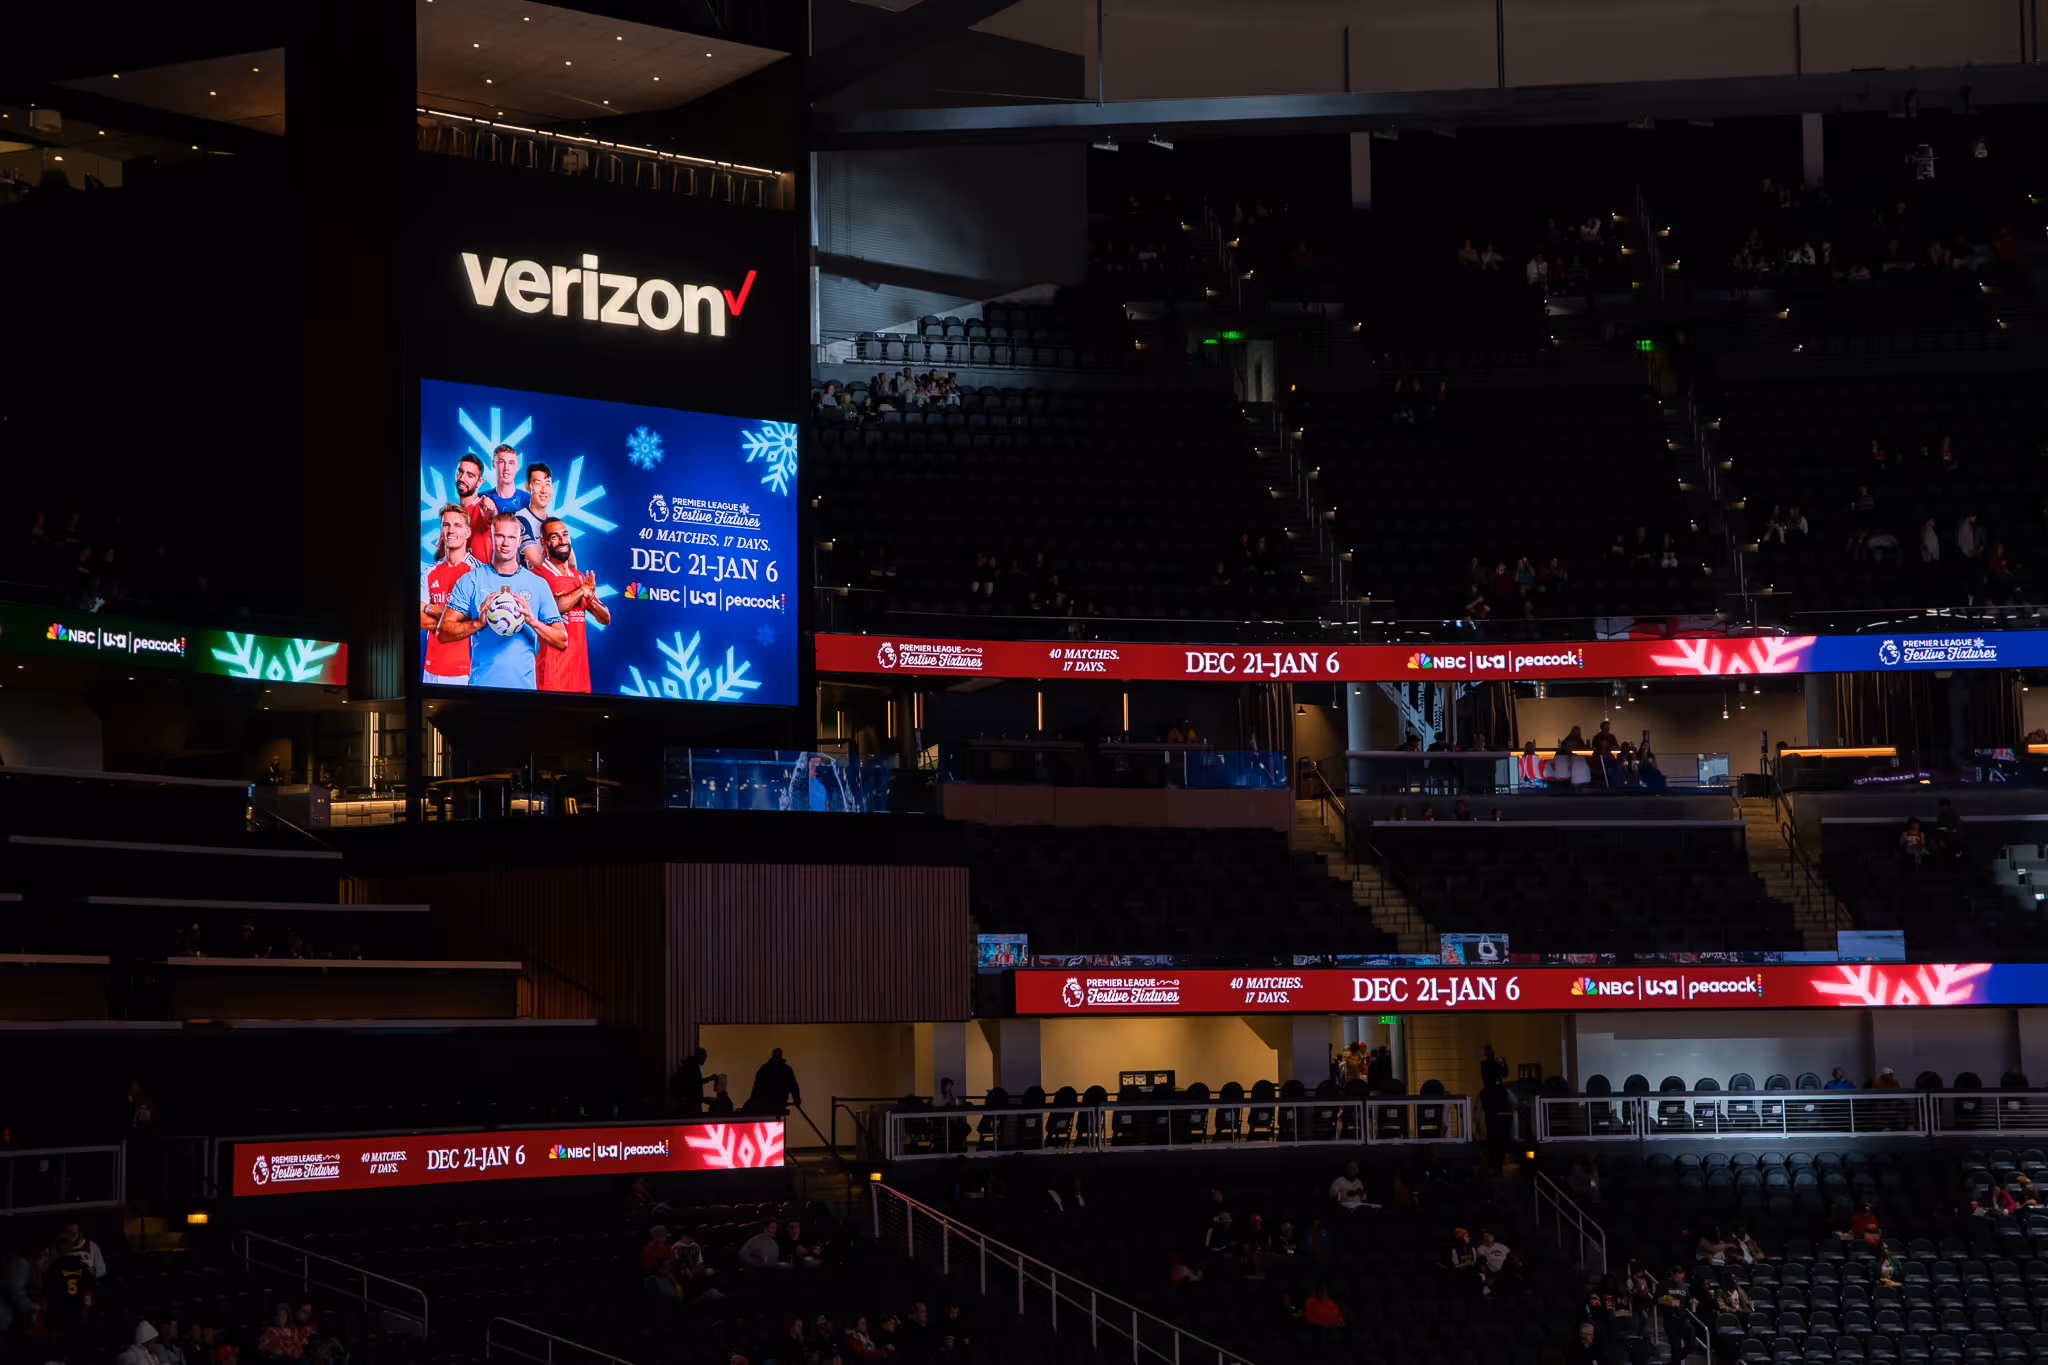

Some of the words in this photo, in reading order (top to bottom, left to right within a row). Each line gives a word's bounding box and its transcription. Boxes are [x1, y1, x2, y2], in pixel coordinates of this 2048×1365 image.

[461, 252, 726, 337] verizon
[672, 497, 706, 508] PREMIER
[708, 500, 738, 511] LEAGUE
[672, 506, 713, 522] Festive
[714, 510, 761, 527] Fixtures
[639, 528, 653, 539] 40
[656, 529, 719, 547] MATCHES.
[723, 536, 734, 547] 17
[737, 537, 771, 551] DAYS.
[631, 548, 681, 574] DEC
[765, 560, 778, 582] 6
[649, 587, 680, 602] NBC
[725, 595, 781, 611] peacock
[68, 629, 95, 644] NBC
[134, 638, 181, 654] peacock
[900, 644, 932, 653] PREMIER
[933, 645, 961, 653] LEAGUE
[1903, 639, 1939, 647] PREMIER
[1940, 638, 1972, 647] LEAGUE
[900, 652, 937, 666] Festive
[938, 653, 983, 667] Fixtures
[1049, 649, 1062, 659] 40
[1064, 649, 1120, 660] MATCHES.
[1432, 656, 1466, 669] NBC
[1515, 651, 1577, 672] peacock
[1904, 647, 1945, 661] Festive
[1947, 647, 1997, 661] Fixtures
[1063, 662, 1073, 672] 17
[1075, 662, 1106, 672] DAYS.
[1185, 652, 1235, 674] DEC
[1326, 652, 1340, 674] 6
[1087, 978, 1122, 987] PREMIER
[1124, 978, 1156, 987] LEAGUE
[1230, 978, 1243, 989] 40
[1246, 977, 1304, 989] MATCHES.
[1352, 977, 1408, 1002] DEC
[1505, 976, 1520, 1001] 6
[1598, 981, 1634, 996] NBC
[1689, 977, 1757, 999] peacock
[1087, 989, 1129, 1003] Festive
[1130, 989, 1180, 1003] Fixtures
[1245, 992, 1254, 1003] 17
[1257, 992, 1290, 1003] DAYS.
[361, 1153, 370, 1163] 40
[371, 1151, 407, 1162] MATCHES.
[427, 1149, 459, 1170] DEC
[515, 1145, 525, 1165] 6
[567, 1148, 591, 1159] NBC
[624, 1141, 665, 1160] peacock
[271, 1155, 298, 1164] PREMIER
[299, 1154, 323, 1163] LEAGUE
[271, 1164, 303, 1179] Festive
[304, 1162, 339, 1178] Fixtures
[370, 1164, 377, 1174] 17
[378, 1163, 399, 1173] DAYS.
